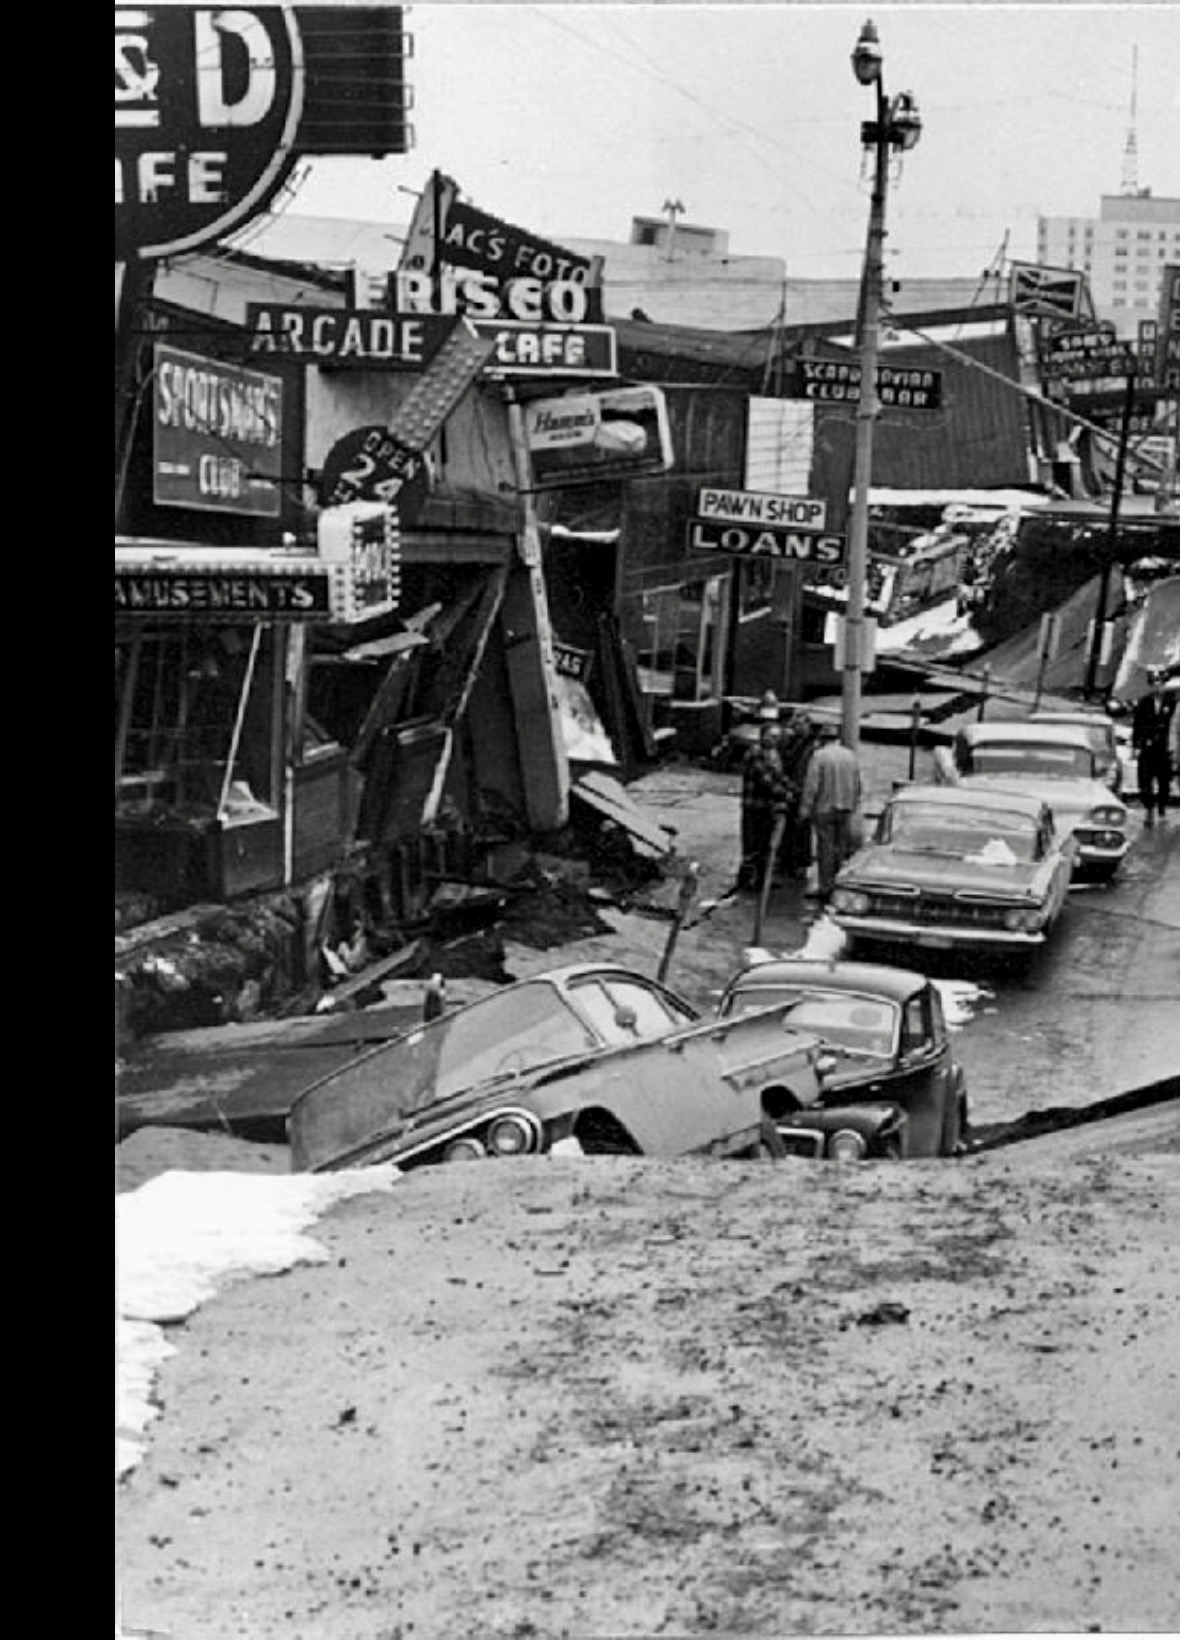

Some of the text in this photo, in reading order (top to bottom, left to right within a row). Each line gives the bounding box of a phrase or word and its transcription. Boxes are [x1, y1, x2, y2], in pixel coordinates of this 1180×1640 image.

[194, 10, 277, 128] D
[445, 223, 591, 288] AC'S FOTO
[251, 310, 425, 363] ARCADE
[496, 330, 586, 365] CAFE
[340, 453, 404, 502] 24
[363, 431, 421, 480] OPEN
[703, 491, 822, 524] PAWN SHOP
[692, 525, 841, 561] LOANS
[115, 579, 315, 609] AMUSEMENTS
